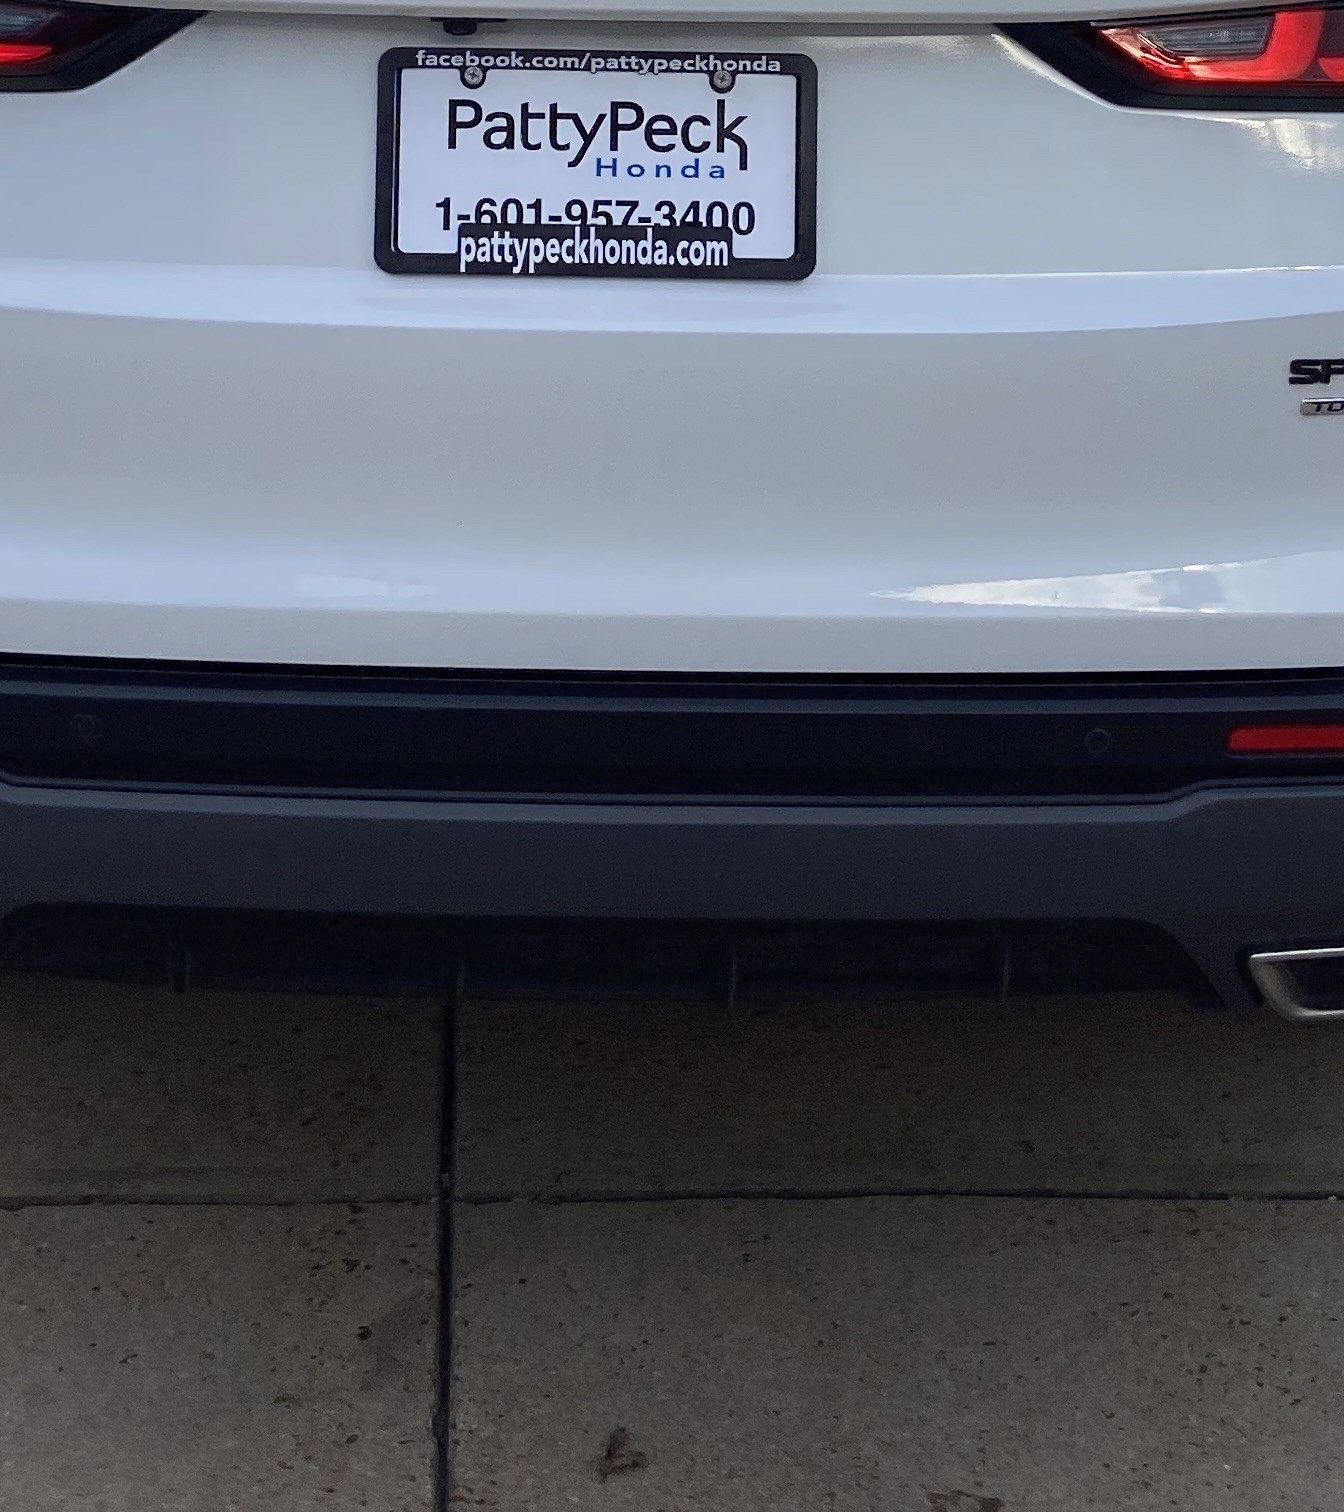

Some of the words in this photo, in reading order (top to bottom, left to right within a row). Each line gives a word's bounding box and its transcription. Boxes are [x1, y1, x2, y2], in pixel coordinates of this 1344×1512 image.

[415, 49, 781, 75] facebook.com/pattypeckhonda
[446, 98, 749, 171] PattyPeck
[595, 157, 726, 179] Honda
[435, 196, 756, 236] 1-601-957-3400
[459, 227, 729, 274] pattypeckhonda.com
